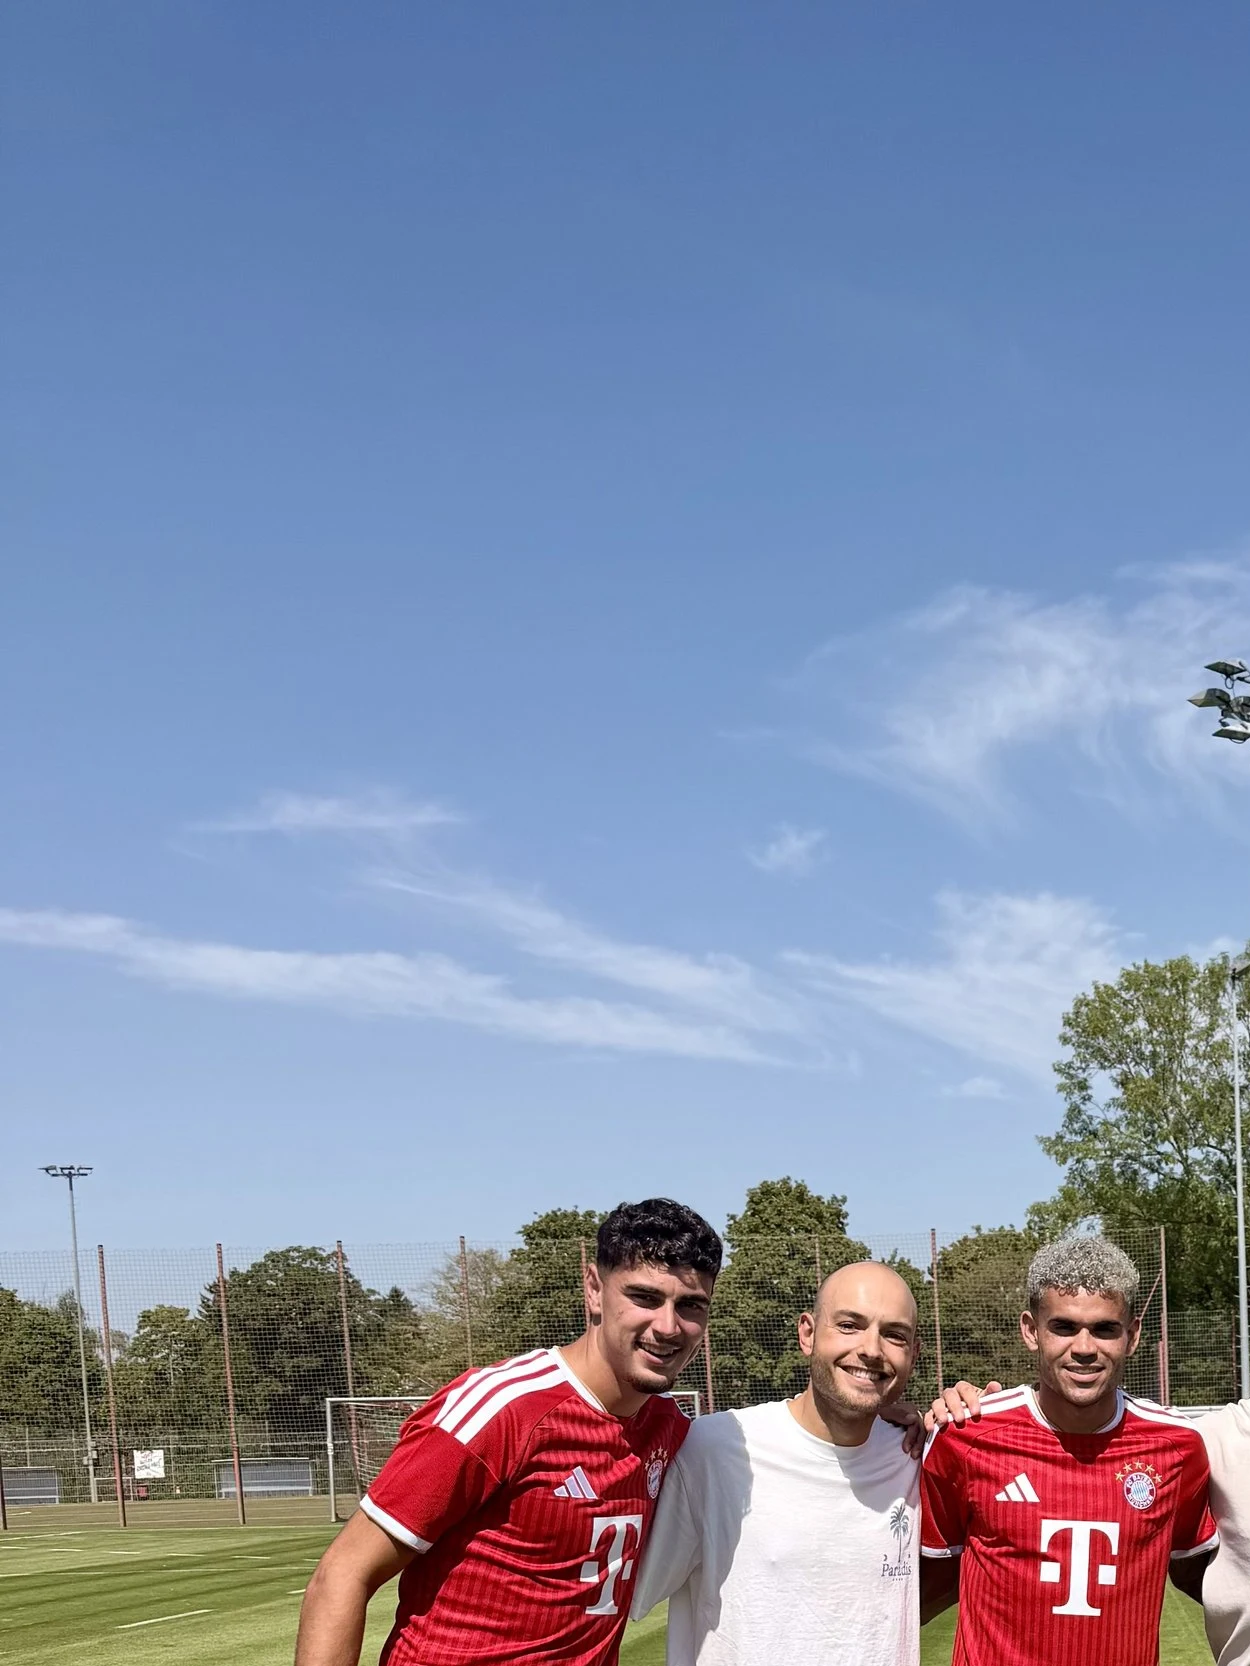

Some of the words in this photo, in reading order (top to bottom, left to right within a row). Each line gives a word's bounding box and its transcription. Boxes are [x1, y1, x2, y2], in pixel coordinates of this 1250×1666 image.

[580, 1514, 643, 1615] T
[881, 1561, 912, 1577] Paradis
[1040, 1519, 1120, 1616] T
